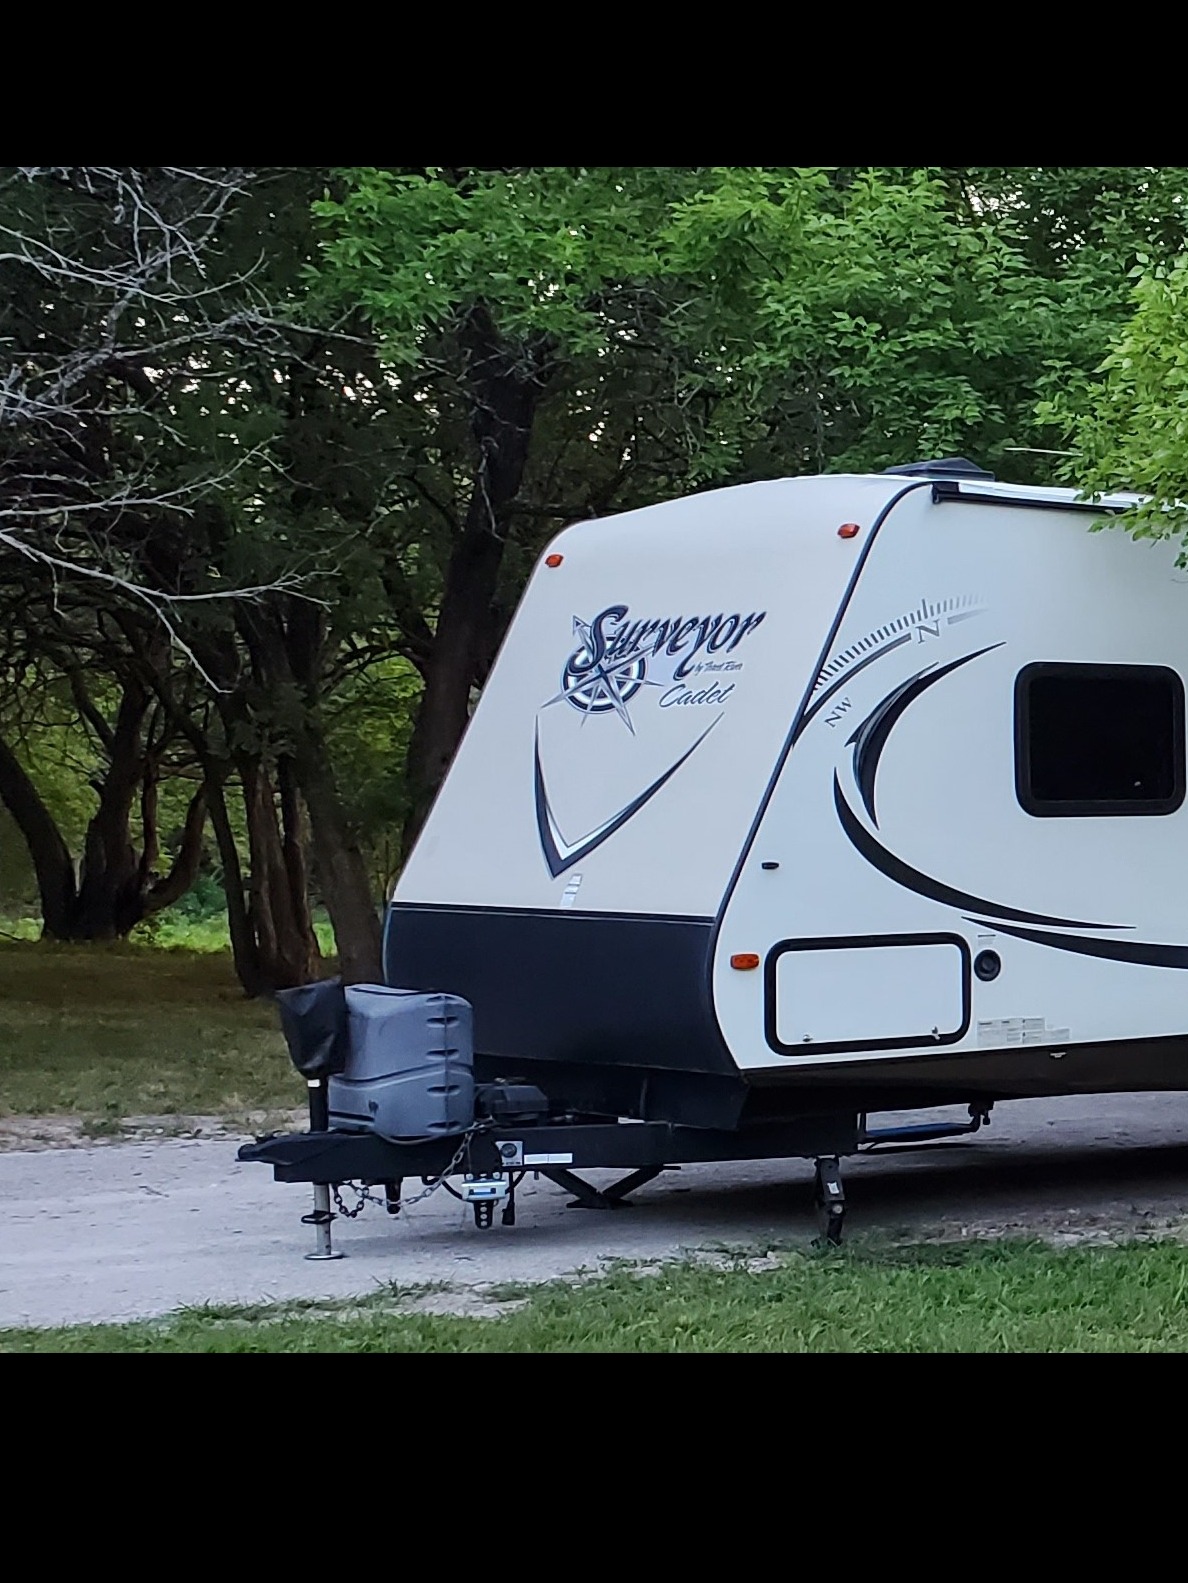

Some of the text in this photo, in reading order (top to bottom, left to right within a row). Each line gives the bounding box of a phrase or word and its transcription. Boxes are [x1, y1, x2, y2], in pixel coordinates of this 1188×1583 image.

[566, 604, 767, 681] Surveyor
[915, 619, 941, 644] N
[659, 681, 736, 708] Cadet
[824, 697, 852, 728] NW
